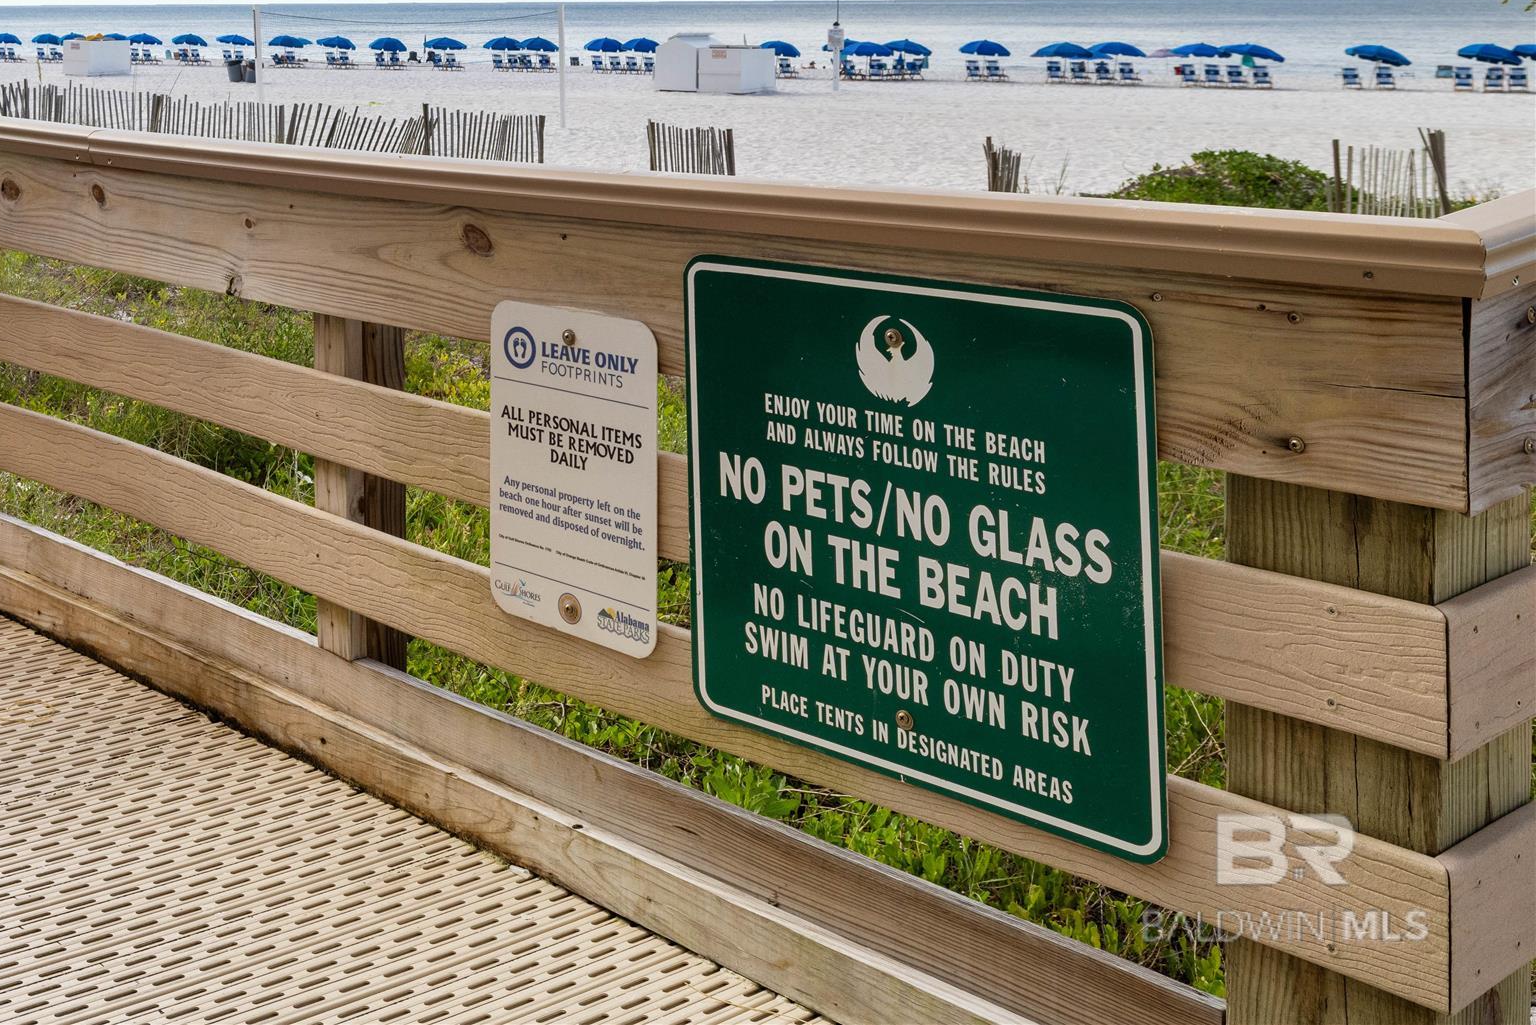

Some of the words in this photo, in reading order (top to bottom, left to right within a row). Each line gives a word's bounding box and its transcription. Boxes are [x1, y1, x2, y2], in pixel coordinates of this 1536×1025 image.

[541, 341, 591, 366] LEAVE
[594, 351, 639, 374] ONLY
[541, 360, 623, 389] FOOTPRINTS
[501, 404, 525, 422] ALL
[528, 409, 598, 439] PERSONAL
[601, 426, 642, 449] ITEMS
[507, 422, 544, 443] MUST
[548, 431, 564, 448] BE
[568, 436, 634, 464] REMOVED
[764, 392, 810, 420] ENJOY
[816, 401, 857, 429] YOUR
[864, 409, 904, 438] TIME
[912, 418, 936, 444] ON
[943, 423, 977, 451] THE
[985, 431, 1046, 464] BEACH
[550, 448, 588, 471] DAILY
[766, 420, 797, 445] AND
[804, 427, 865, 459] ALWAYS
[872, 439, 938, 473] FOLLOW
[946, 454, 980, 482] THE
[988, 462, 1046, 495] RULES
[499, 487, 522, 503] beach
[525, 495, 540, 507] one
[541, 499, 561, 513] hour
[562, 505, 582, 519] after
[584, 511, 612, 527] sunset
[614, 519, 630, 532] will
[632, 523, 643, 536] be
[503, 475, 520, 490] Any
[521, 481, 556, 498] personal
[558, 491, 595, 510] property
[597, 499, 611, 513] left
[613, 506, 624, 516] on
[627, 508, 641, 521] the
[719, 451, 766, 505] NO
[781, 463, 951, 547] PETS/NO
[968, 504, 1113, 585] GLASS
[499, 503, 534, 520] removed
[535, 511, 551, 524] and
[552, 516, 589, 535] disposed
[590, 527, 600, 538] of
[601, 532, 645, 552] overnight.
[764, 520, 813, 577] ON
[827, 534, 901, 600] THE
[918, 555, 1059, 641] BEACH
[615, 611, 650, 632] Alabama
[753, 582, 785, 621] NO
[797, 594, 935, 663] LIFEGUARD
[949, 635, 986, 679] ON
[1001, 649, 1075, 703] DUTY
[744, 621, 809, 670] SWIM
[821, 643, 851, 682] AT
[861, 654, 929, 707] YOUR
[943, 678, 1006, 730] OWN
[1021, 700, 1092, 757] RISK
[761, 684, 809, 719] PLACE
[815, 700, 865, 736] TENTS
[872, 719, 889, 745] IN
[897, 727, 1004, 781] DESIGNATED
[1012, 764, 1073, 805] AREAS
